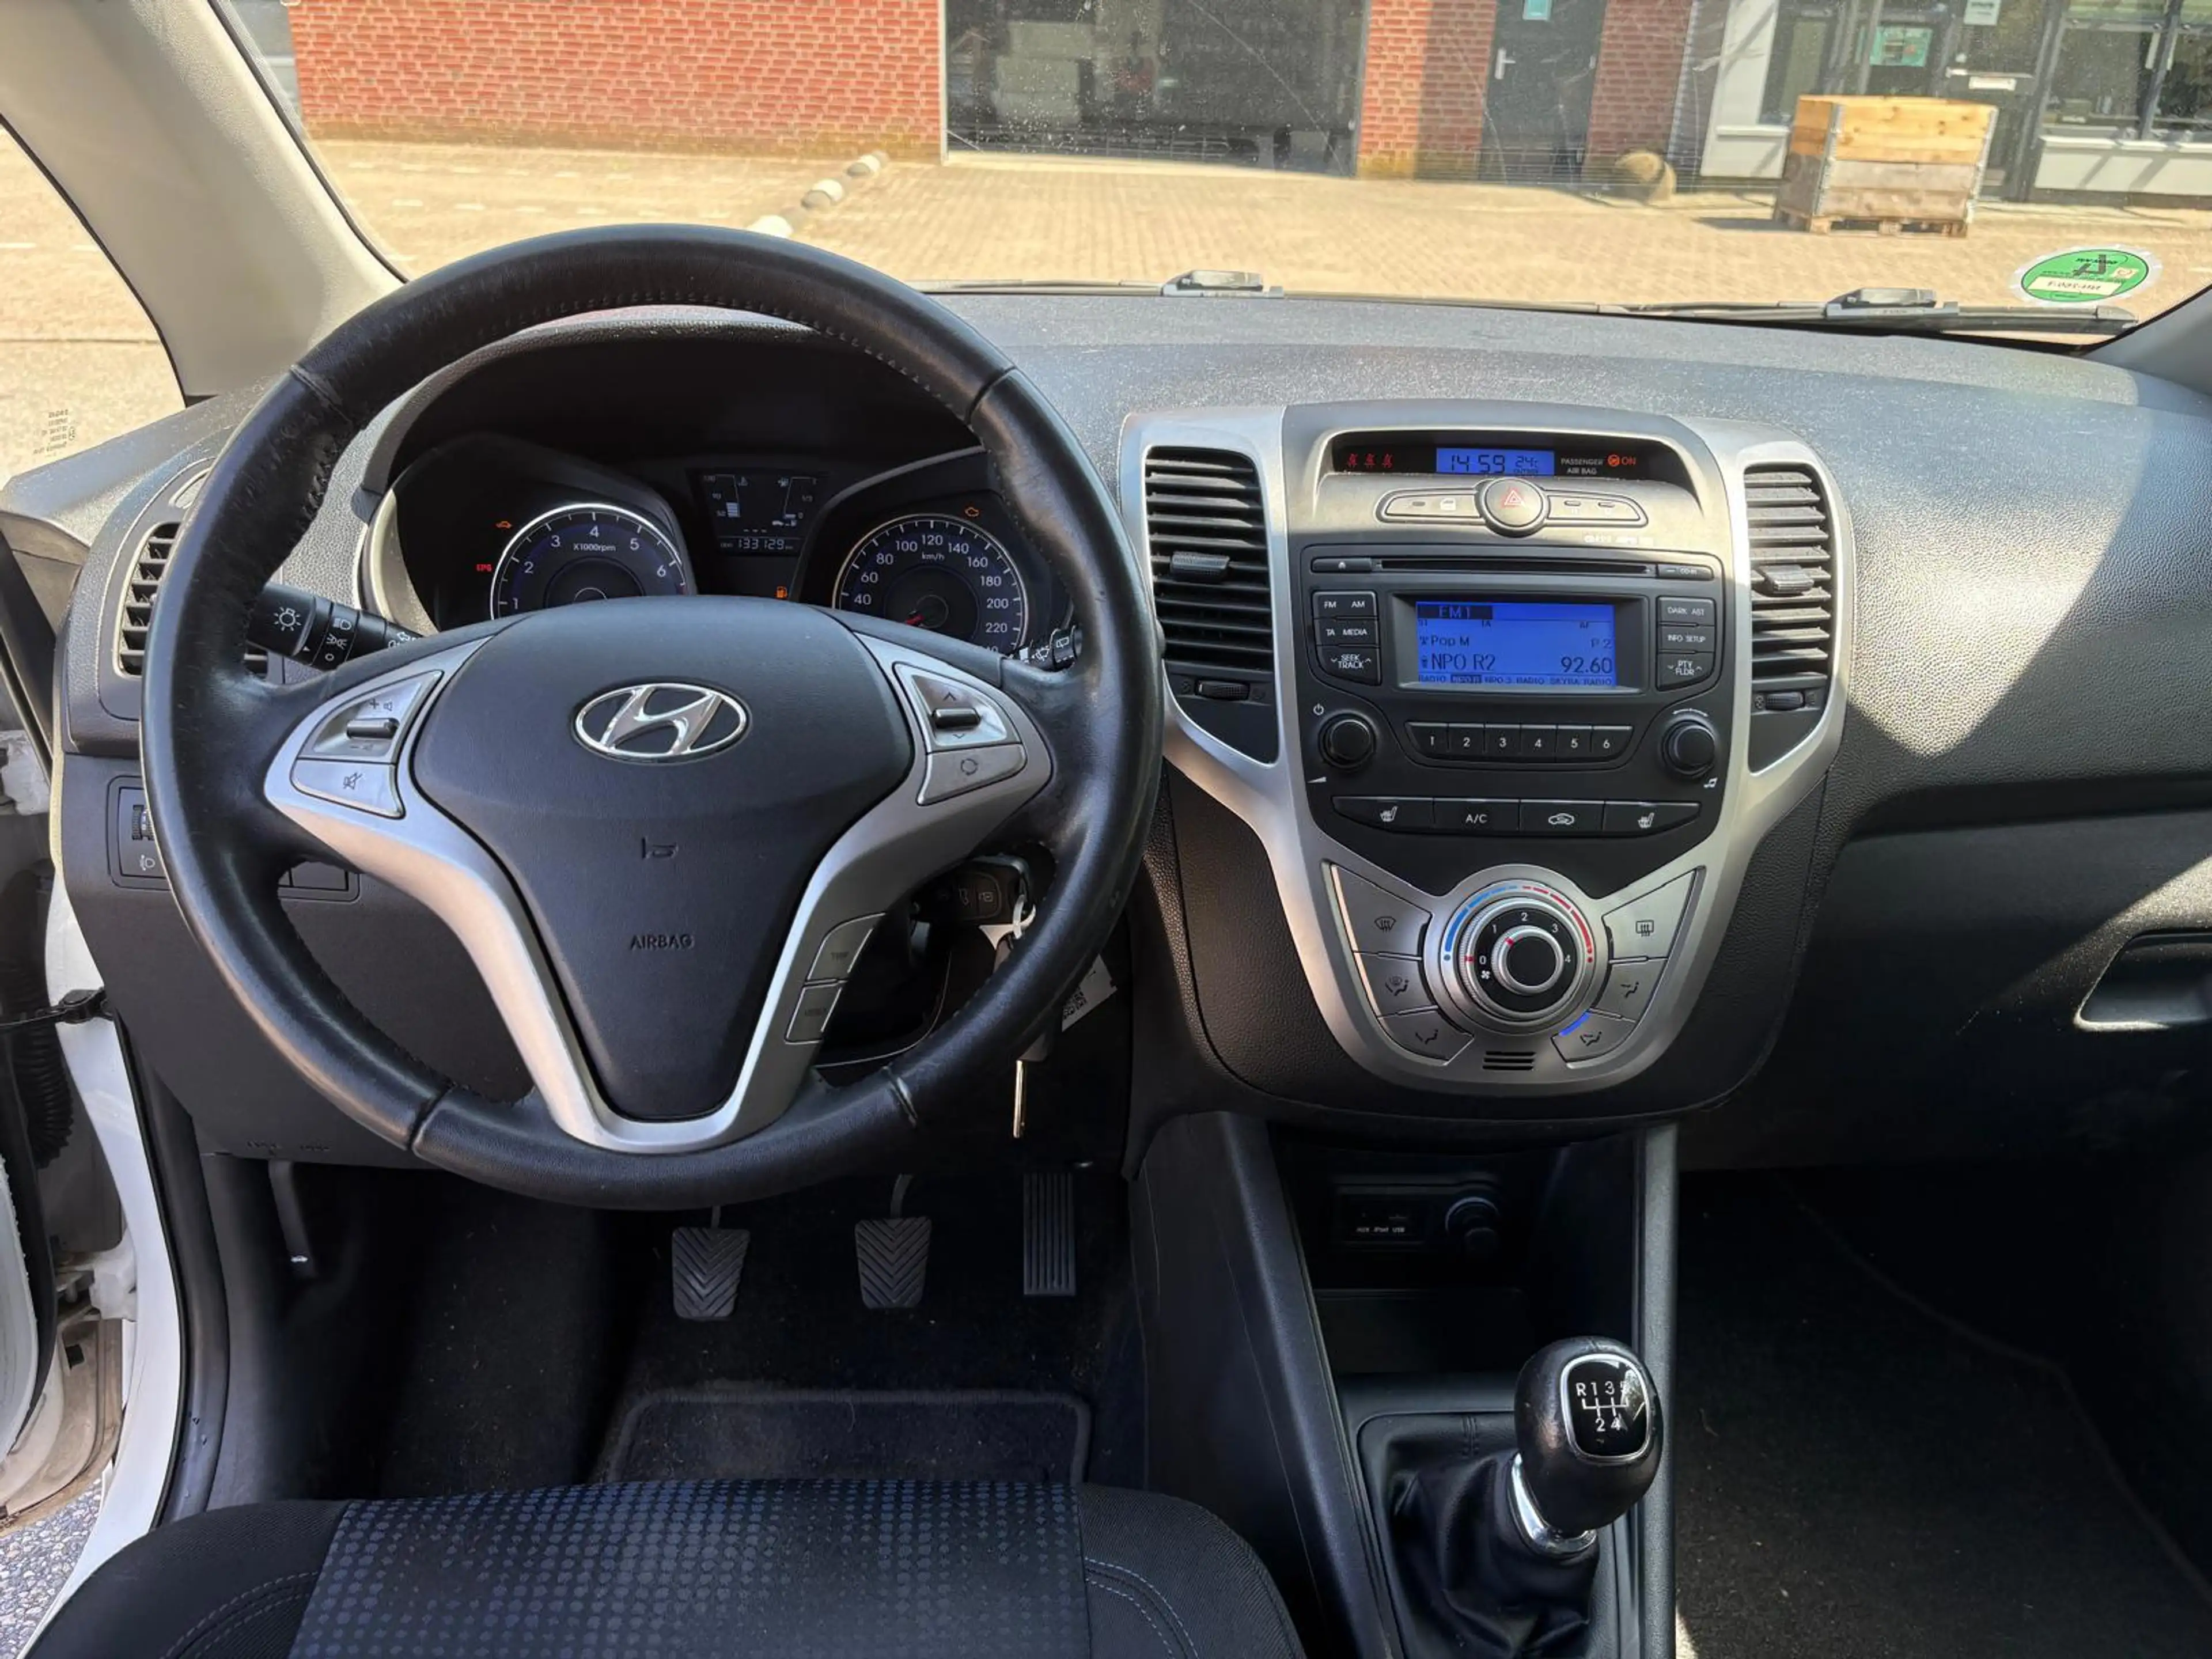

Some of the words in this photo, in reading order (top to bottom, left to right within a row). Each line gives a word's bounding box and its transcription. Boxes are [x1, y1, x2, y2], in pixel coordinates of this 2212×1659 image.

[1560, 457, 1604, 465] PASSENGER
[1581, 467, 1597, 475] BAG
[589, 526, 599, 538] 4
[551, 535, 560, 547] 3
[630, 538, 639, 551] 5
[896, 540, 918, 552] 100
[922, 535, 944, 546] 120
[948, 543, 969, 554] 140
[876, 553, 894, 565] 80
[922, 553, 945, 562] km/h
[967, 556, 988, 567] 160
[524, 561, 534, 574] 2
[657, 566, 666, 577] 6
[861, 572, 878, 584] 60
[980, 576, 1001, 586] 180
[512, 599, 518, 609] 1
[854, 594, 872, 605] 40
[986, 598, 1009, 609] 200
[1667, 607, 1687, 615] DARK
[985, 623, 1007, 634] 220
[1431, 634, 1456, 646] Pop
[1460, 635, 1469, 646] M
[1667, 634, 1683, 642] INFO
[1685, 635, 1706, 643] SETUP
[1340, 654, 1360, 662] SEEK
[1431, 653, 1467, 671] NPO
[1474, 654, 1495, 671] R2
[1338, 661, 1363, 669] TRACK
[1560, 656, 1612, 674] 92.60
[1677, 660, 1693, 669] PTY
[1675, 668, 1695, 676] FLDR
[1430, 737, 1434, 746] 1
[1463, 737, 1471, 748] 2
[1499, 738, 1507, 749] 3
[1534, 738, 1542, 749] 4
[1570, 738, 1578, 749] 5
[1603, 739, 1611, 749] 6
[1465, 813, 1488, 824] A/C
[1521, 912, 1528, 922] 2
[1492, 924, 1497, 934] 1
[1552, 923, 1559, 934] 3
[631, 933, 695, 950] AIRBAG
[1479, 956, 1486, 965] 0
[1564, 956, 1571, 964] 4
[1575, 1382, 1586, 1397] R
[1590, 1382, 1597, 1396] 1
[1605, 1381, 1615, 1395] 3
[1595, 1418, 1606, 1432] 2
[1611, 1416, 1622, 1431] 4
